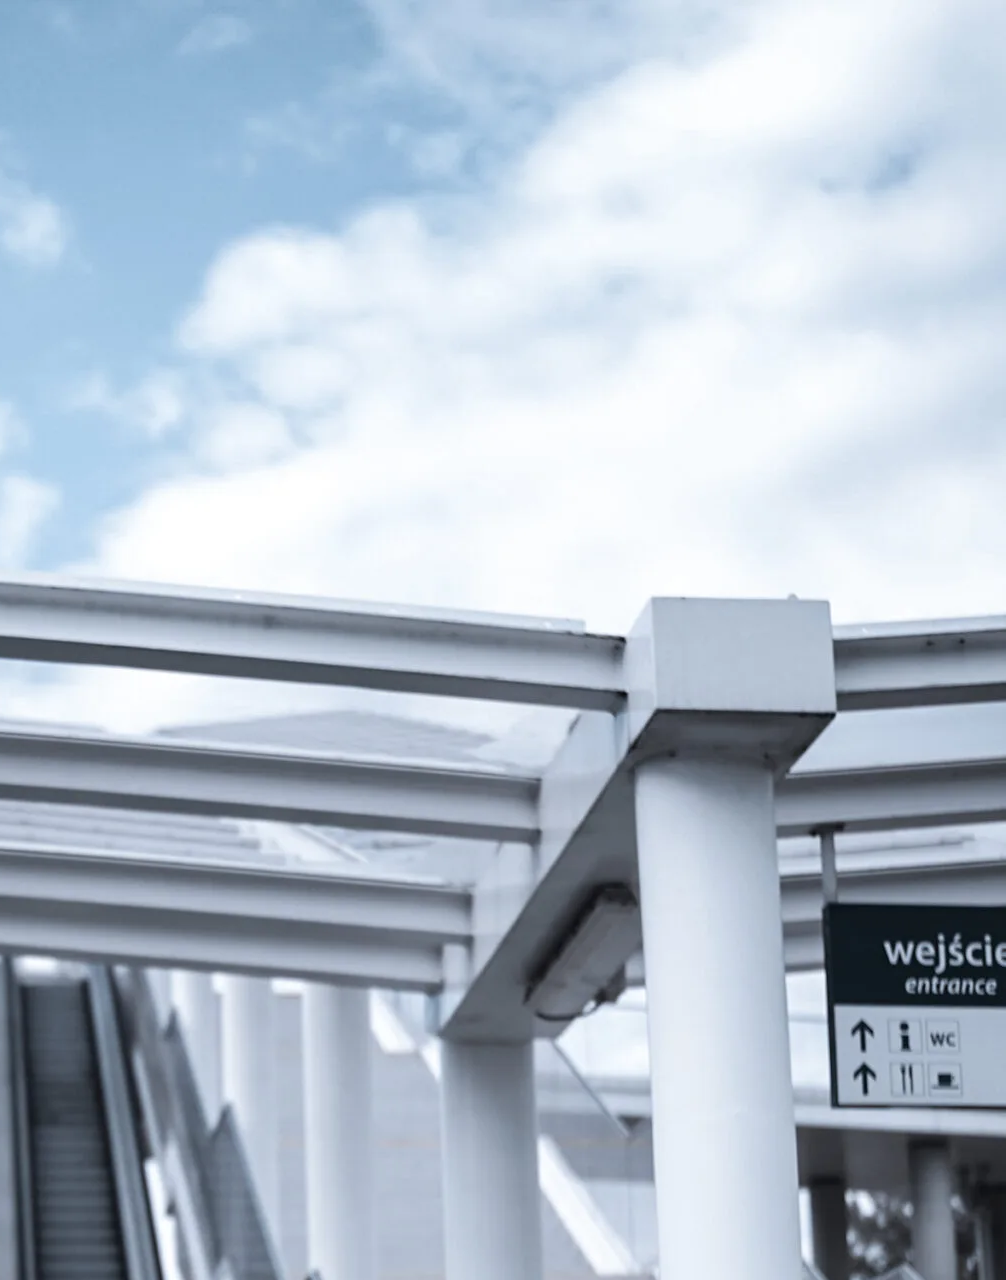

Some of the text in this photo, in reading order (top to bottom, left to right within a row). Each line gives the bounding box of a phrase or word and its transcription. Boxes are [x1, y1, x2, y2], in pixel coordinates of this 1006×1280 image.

[883, 933, 1006, 974] wejście
[904, 976, 997, 995] entrance
[930, 1032, 956, 1047] WC
